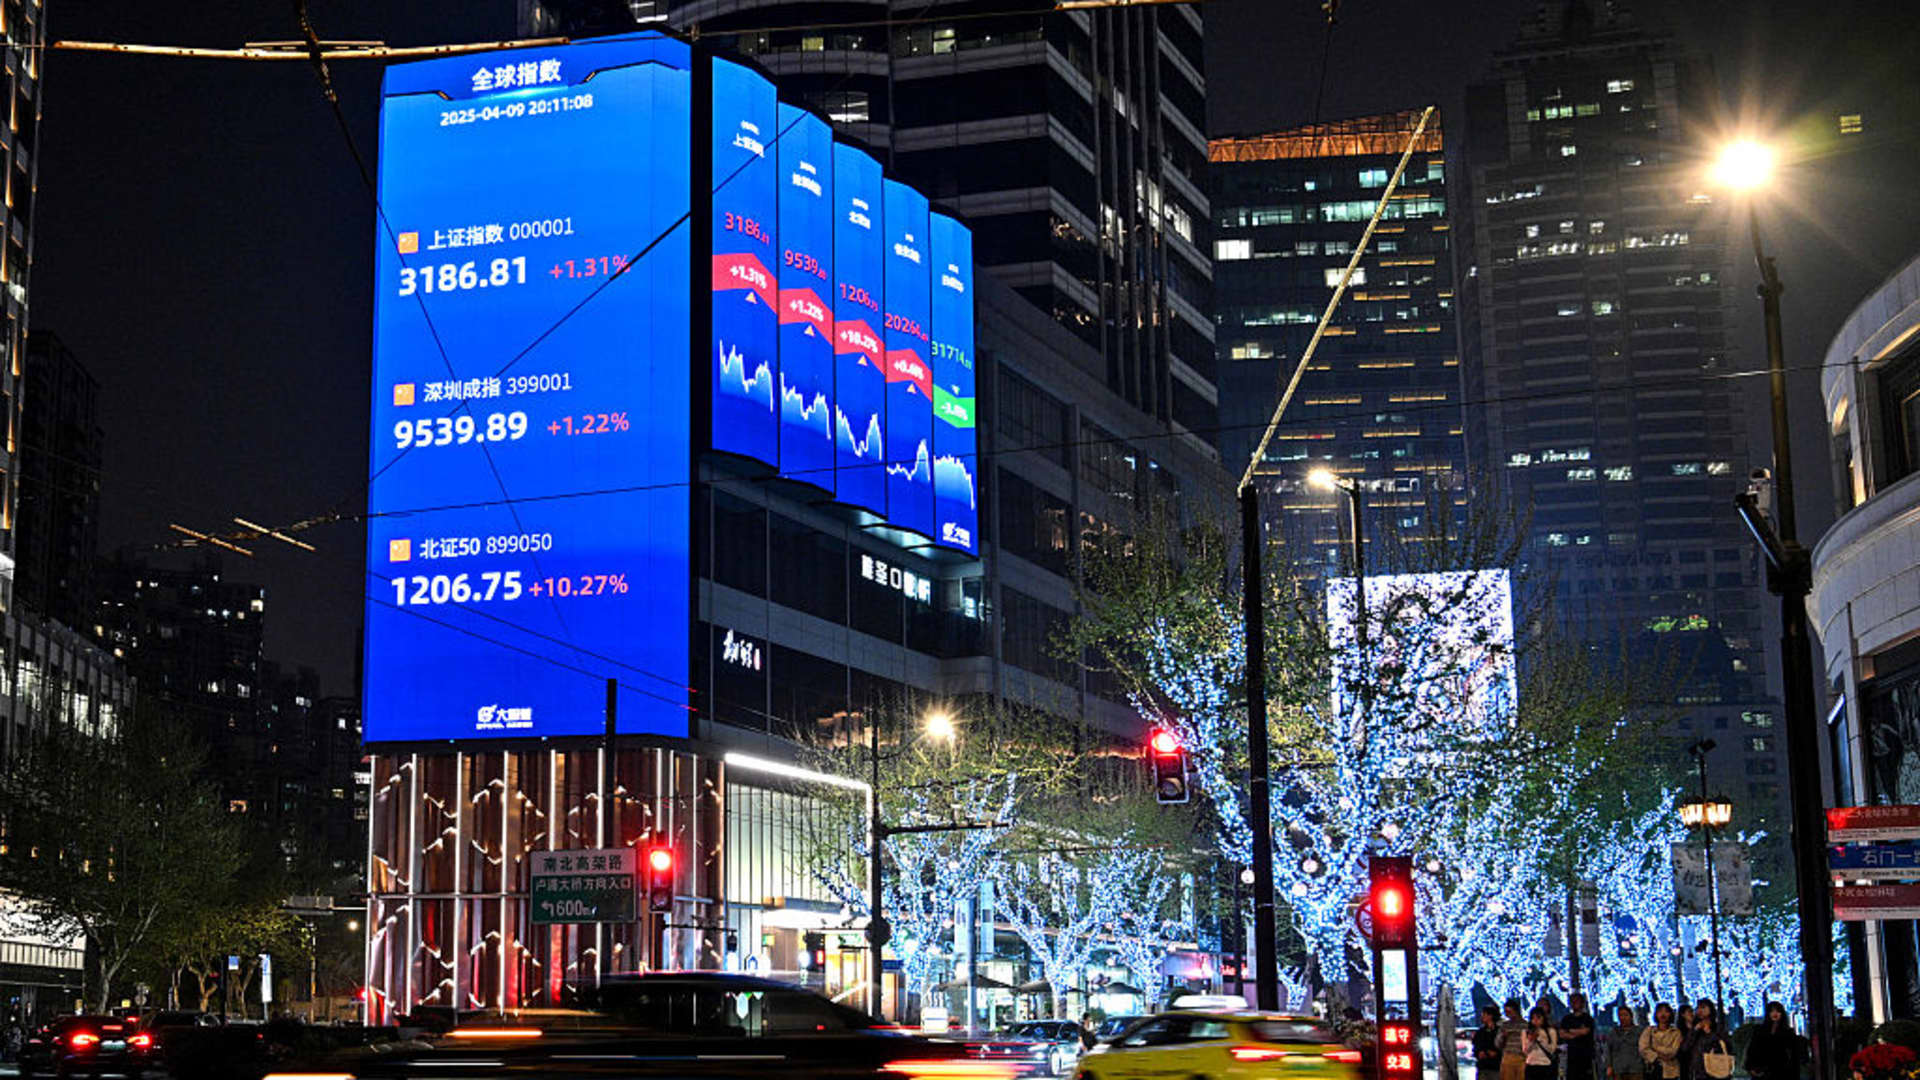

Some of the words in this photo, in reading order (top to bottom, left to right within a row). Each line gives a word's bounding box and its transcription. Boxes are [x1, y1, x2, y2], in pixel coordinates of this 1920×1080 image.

[440, 103, 525, 126] 2025-04-09
[528, 94, 593, 116] 20:11:08
[427, 224, 504, 250] 上证指数
[509, 217, 574, 240] 000001
[398, 256, 527, 296] 3186.81
[550, 254, 631, 279] +1.31%
[423, 377, 501, 402] 深圳成指
[506, 372, 572, 394] 399001
[392, 411, 528, 449] 9539.89
[547, 412, 630, 436] +1.22%
[419, 538, 481, 559] 北证50
[486, 533, 553, 554] 899050
[391, 571, 523, 606] 1206.75
[528, 574, 629, 597] +10.27%
[543, 854, 623, 872] 南北高架路
